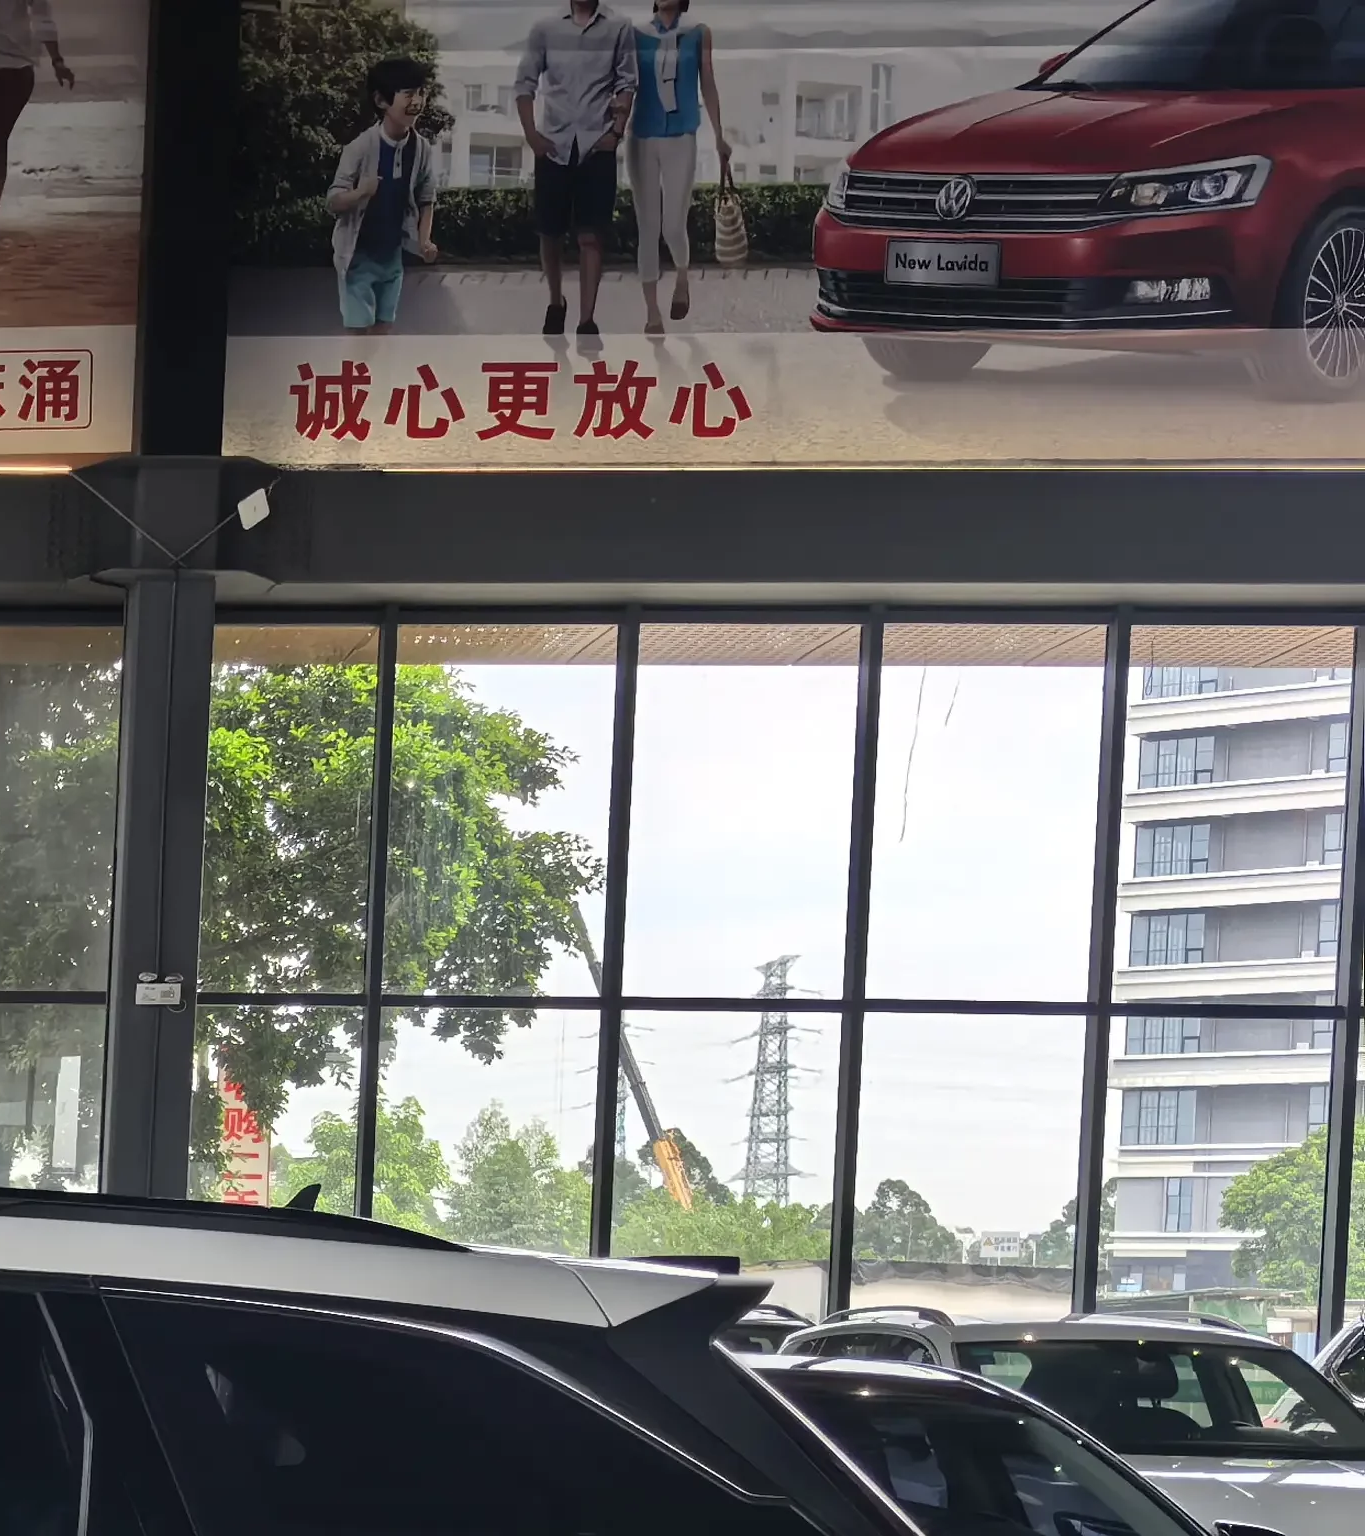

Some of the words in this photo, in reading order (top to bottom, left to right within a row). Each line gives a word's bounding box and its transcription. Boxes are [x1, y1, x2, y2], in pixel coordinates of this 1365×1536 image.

[895, 252, 931, 270] New
[937, 253, 989, 272] Lavida
[289, 360, 753, 442] 诚心更放心
